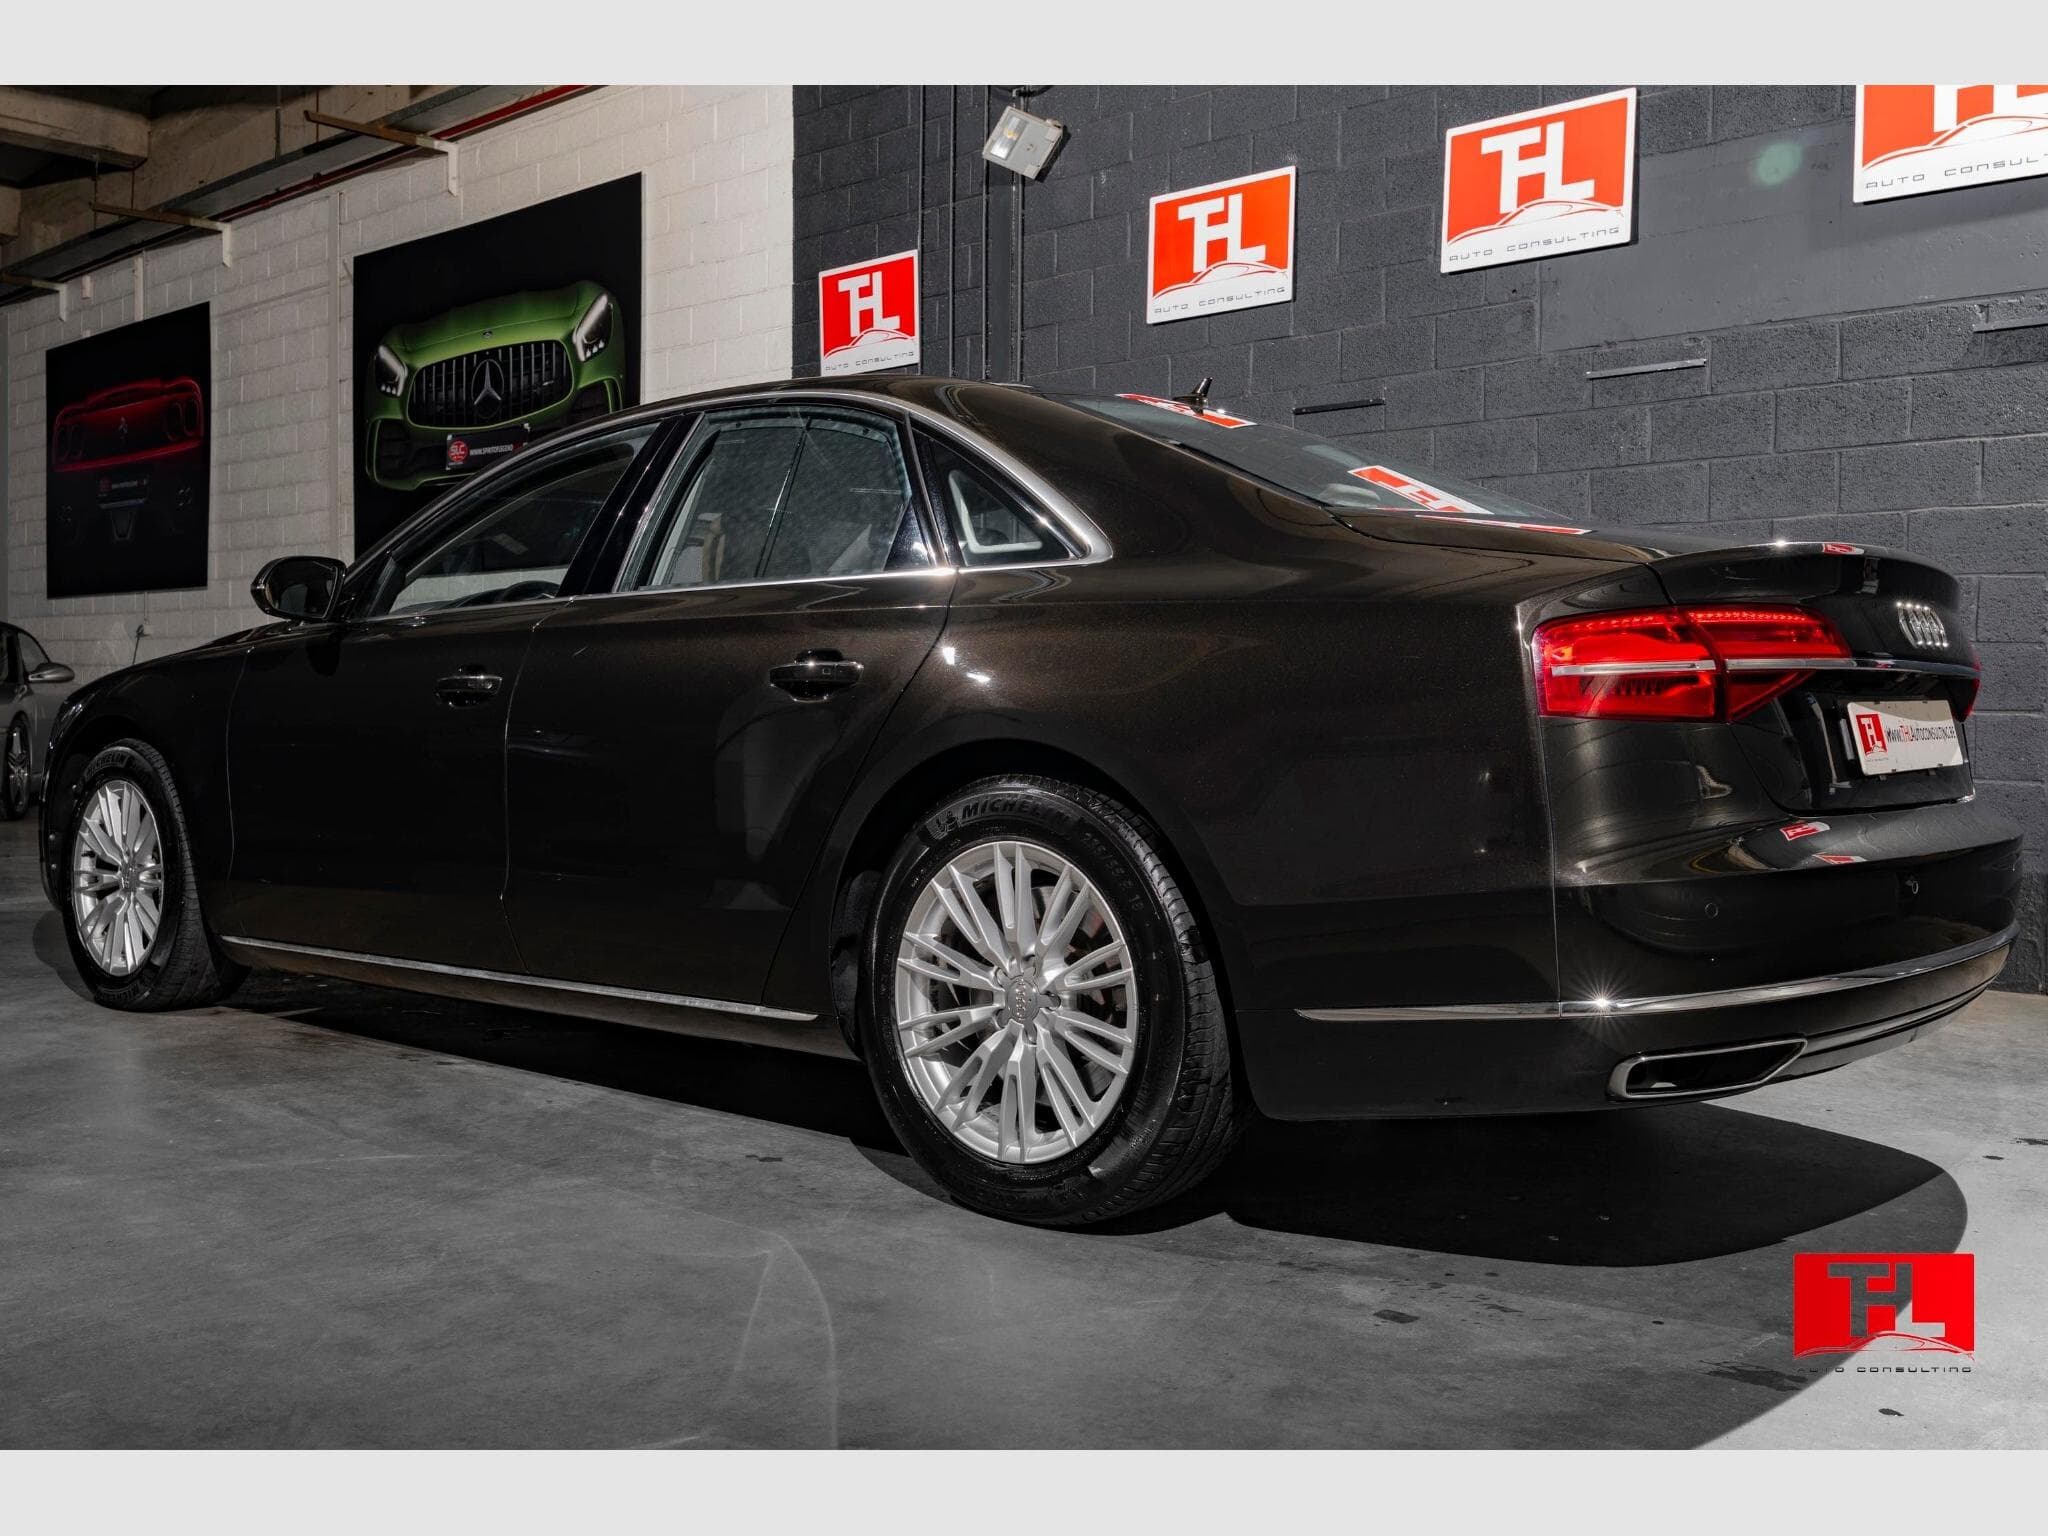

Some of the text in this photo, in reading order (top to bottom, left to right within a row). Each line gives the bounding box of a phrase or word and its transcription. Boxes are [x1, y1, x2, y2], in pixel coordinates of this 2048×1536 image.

[1866, 153, 2048, 189] AUTO CONSUL
[1449, 227, 1620, 262] AUTO CONSULTING
[1154, 287, 1286, 314] AUTO CONSULTING
[855, 351, 915, 366] CONSULTING
